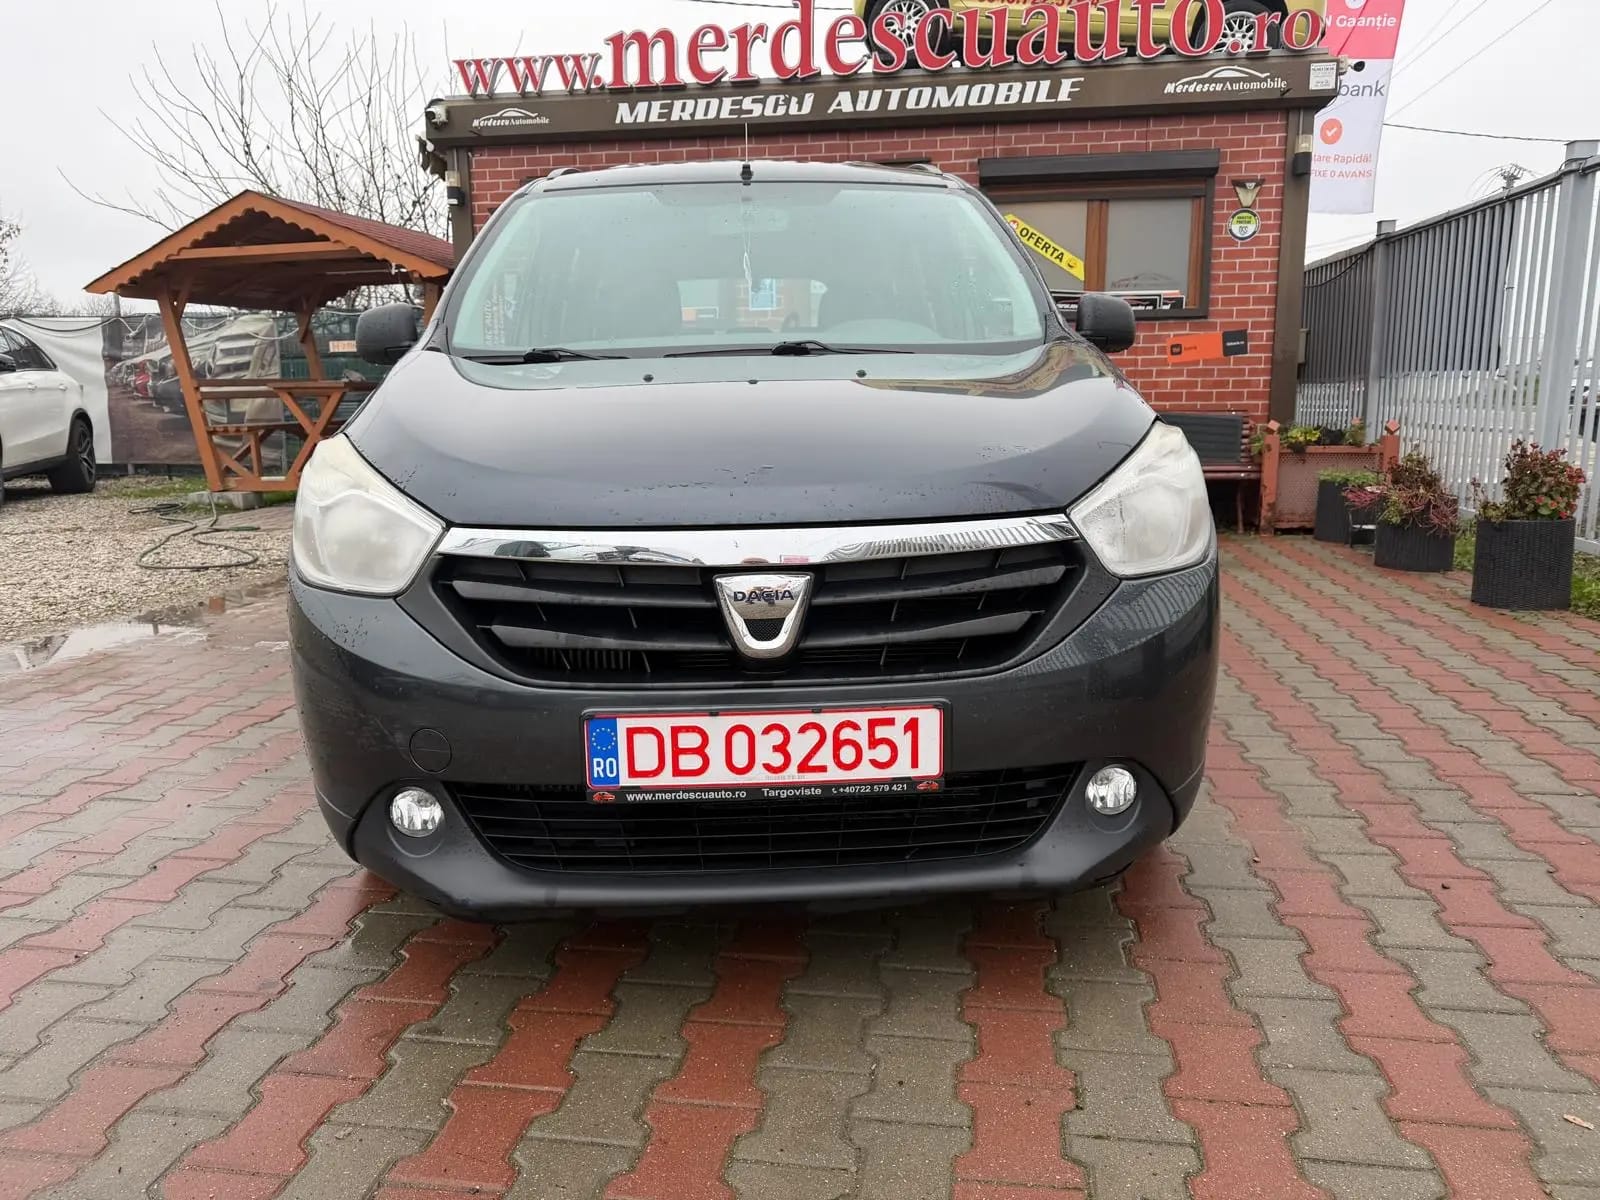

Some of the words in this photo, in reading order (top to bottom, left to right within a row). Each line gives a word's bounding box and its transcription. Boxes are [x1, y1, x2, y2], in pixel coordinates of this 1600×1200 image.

[453, 0, 1322, 98] www.merdescuauto.ro
[615, 92, 815, 124] MERDESCU
[827, 76, 1084, 114] AUTOMOBILE
[1338, 169, 1373, 179] AVANS
[1019, 227, 1065, 263] OFERTA
[733, 589, 795, 602] DACIA
[625, 724, 711, 779] DB
[724, 716, 920, 776] 032651
[593, 757, 618, 779] RO
[626, 789, 747, 801] www.merdescuauto.ro
[762, 786, 822, 799] Targoviste
[838, 785, 871, 794] +40722
[873, 784, 890, 793] 579
[891, 783, 907, 792] 421
